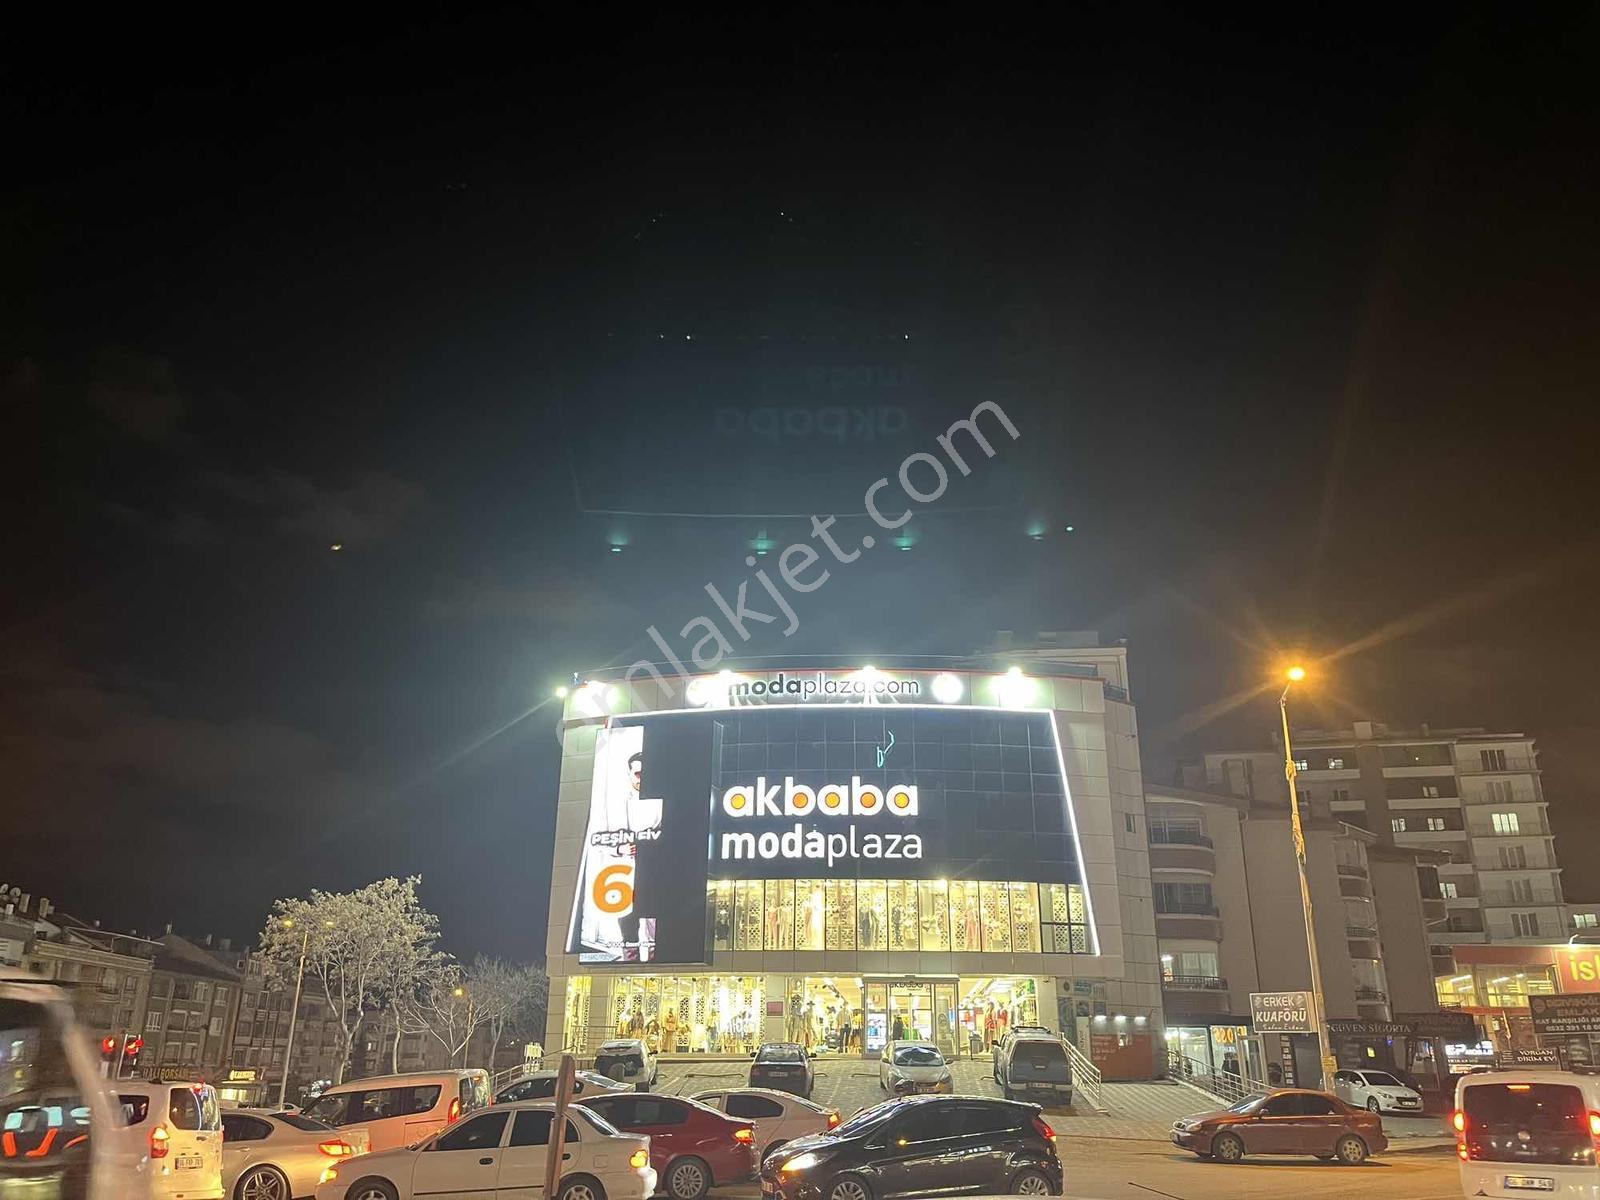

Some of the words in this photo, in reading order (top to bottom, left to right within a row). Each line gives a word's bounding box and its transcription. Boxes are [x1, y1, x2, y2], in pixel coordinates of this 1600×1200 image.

[728, 672, 919, 700] modaplazacom
[722, 776, 919, 817] akbaba
[721, 823, 923, 867] modaplaza
[592, 864, 633, 913] 6
[1263, 996, 1295, 1007] ERKEK
